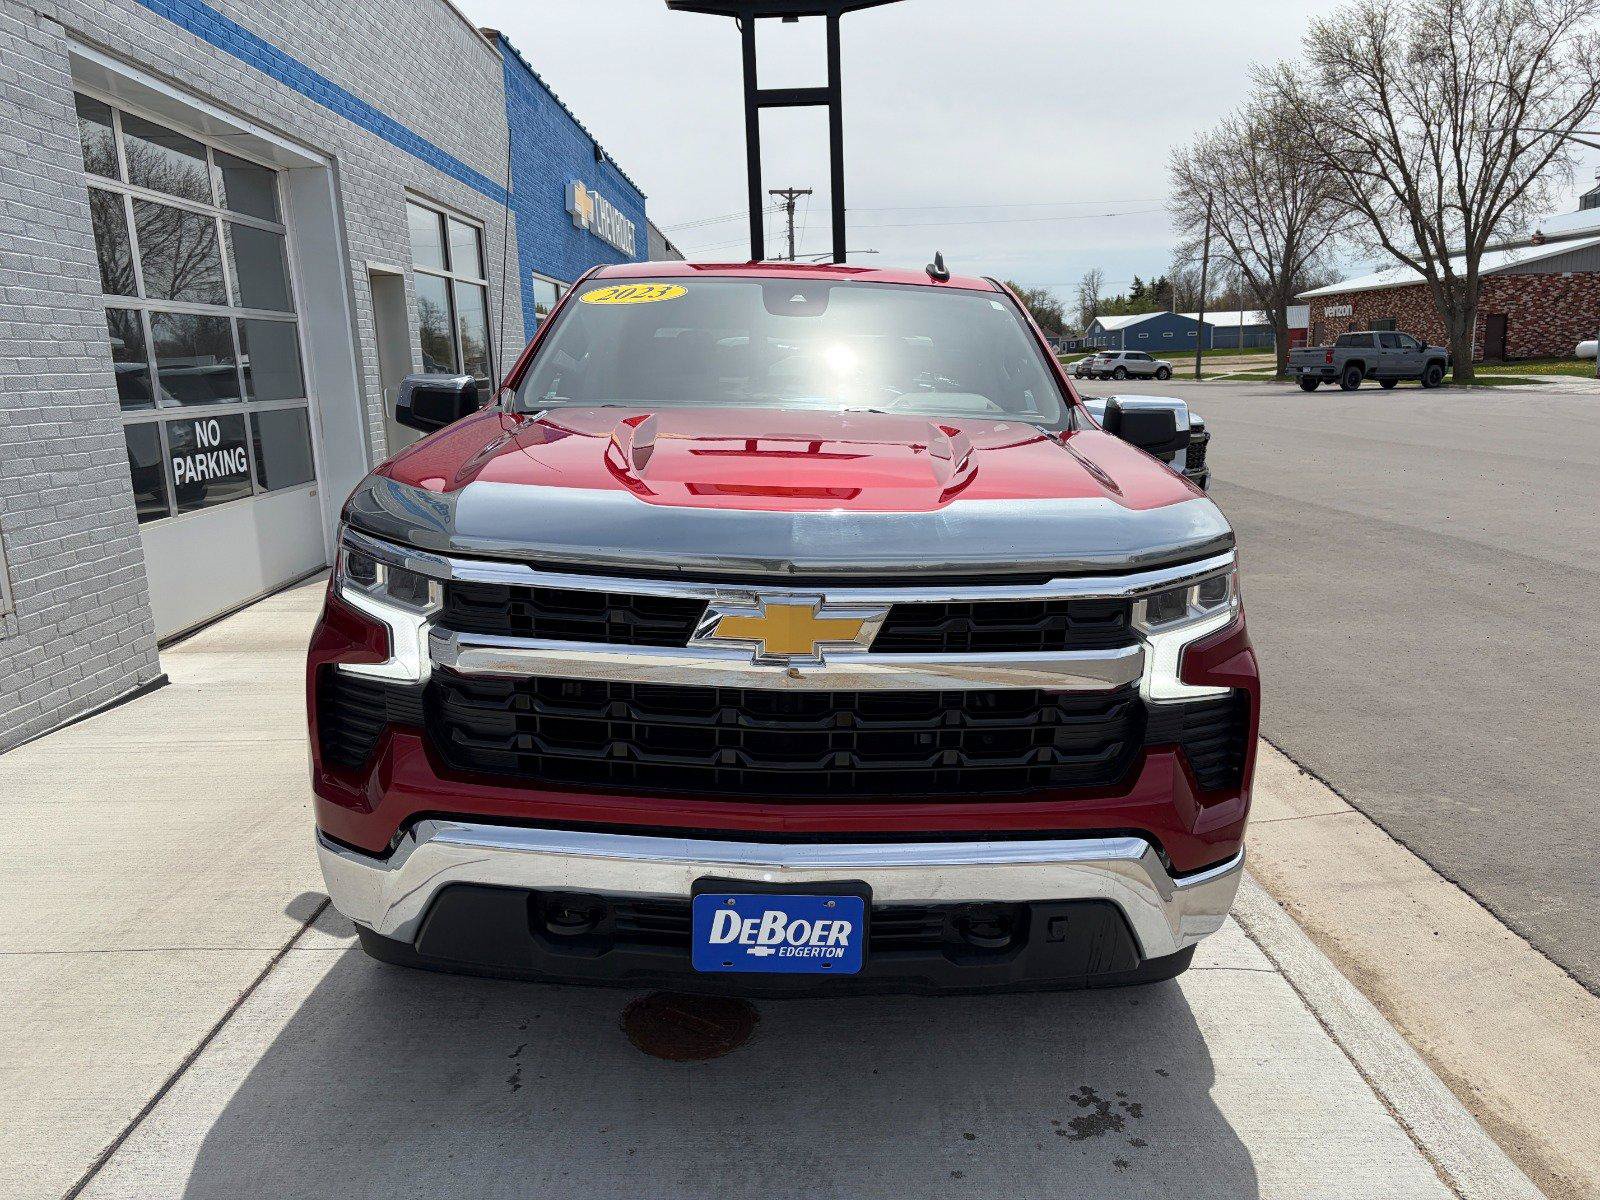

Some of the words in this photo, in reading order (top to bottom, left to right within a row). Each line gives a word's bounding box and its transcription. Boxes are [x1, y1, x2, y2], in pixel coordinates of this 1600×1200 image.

[594, 190, 636, 257] CHEVROLET
[595, 286, 672, 302] 2023
[1324, 304, 1353, 317] verizon
[194, 419, 221, 448] NO
[172, 446, 248, 486] PARKING
[778, 946, 845, 958] EDGERTON
